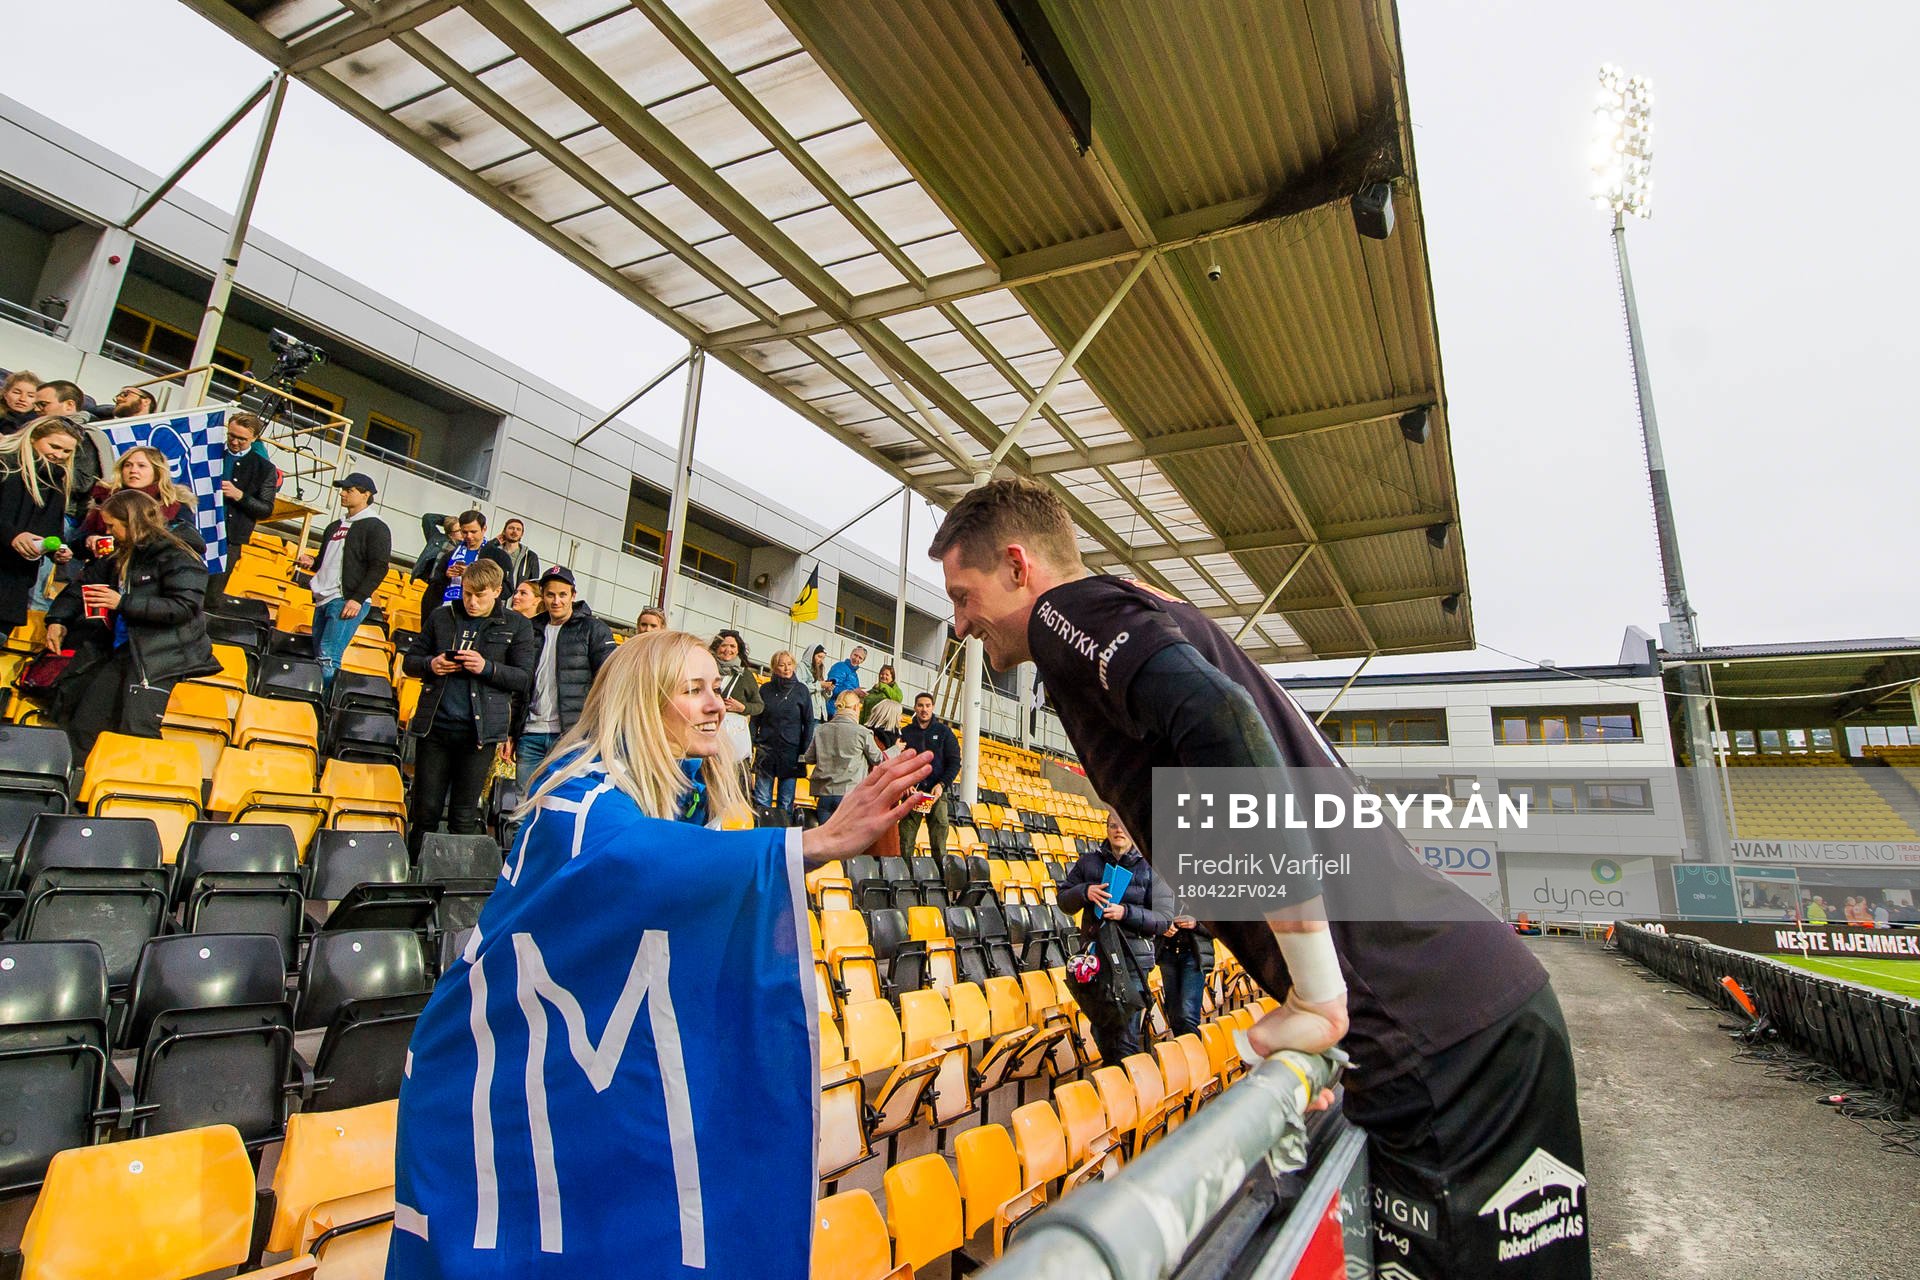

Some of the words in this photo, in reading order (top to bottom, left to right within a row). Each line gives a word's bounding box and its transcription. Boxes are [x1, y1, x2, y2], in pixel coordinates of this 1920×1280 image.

[1037, 600, 1099, 661] FAGTRYKK
[1424, 846, 1491, 870] BDO
[1787, 843, 1895, 861] INVEST.NO
[1533, 877, 1625, 914] dynea
[1775, 930, 1830, 951] NESTE
[1831, 932, 1920, 955] HJEMMEK
[1374, 1221, 1410, 1256] ing
[1498, 1234, 1536, 1262] Robert
[1565, 1214, 1584, 1238] AS
